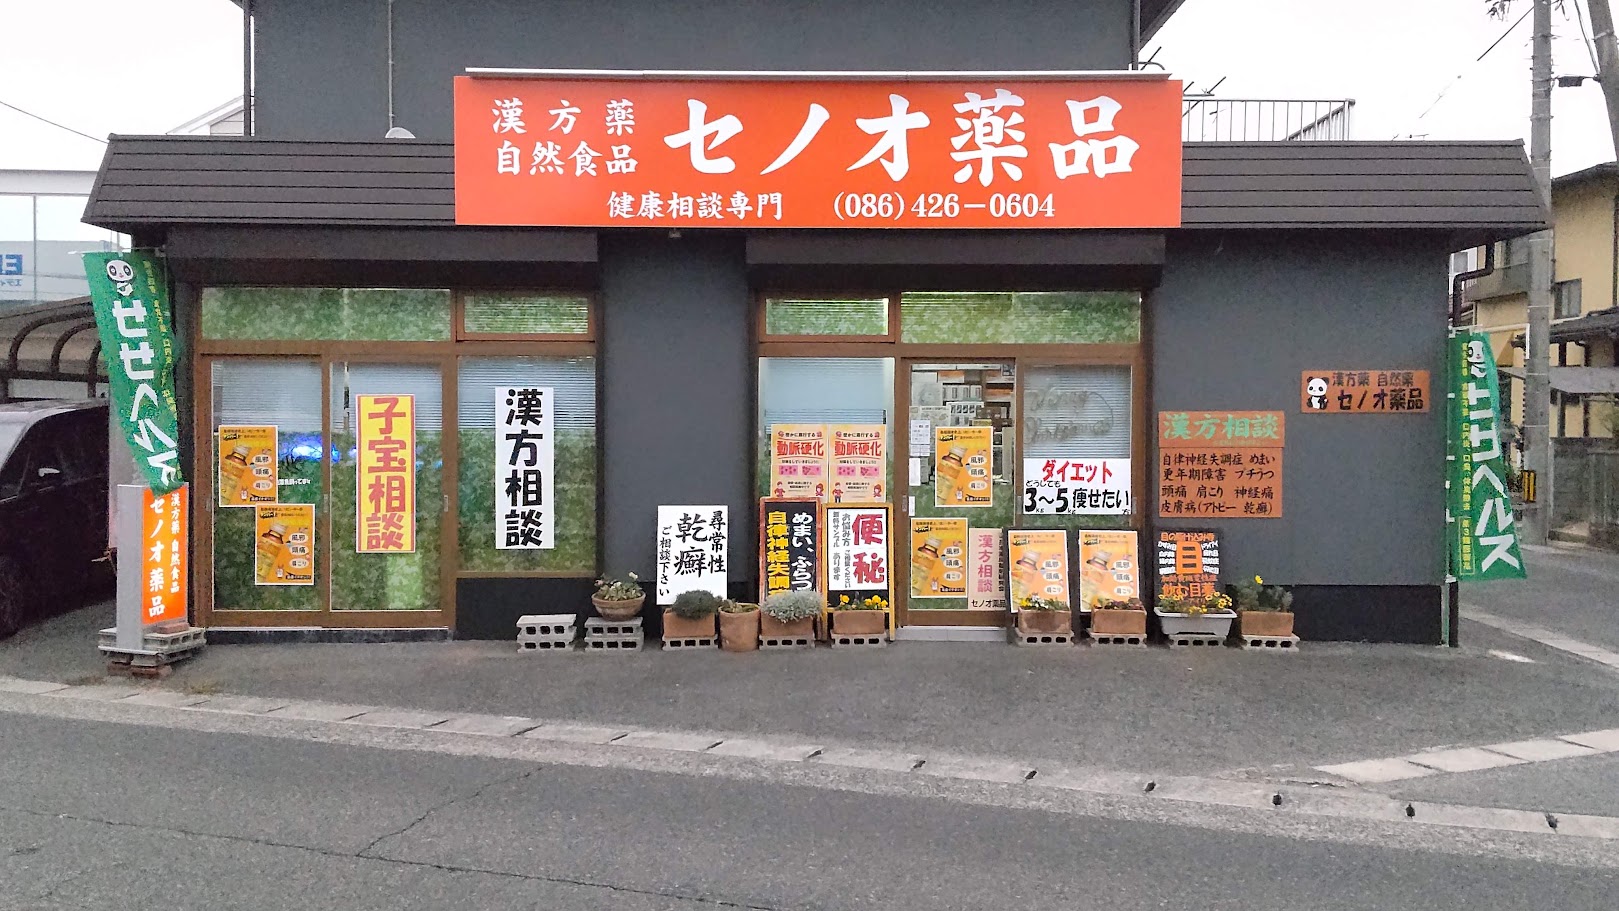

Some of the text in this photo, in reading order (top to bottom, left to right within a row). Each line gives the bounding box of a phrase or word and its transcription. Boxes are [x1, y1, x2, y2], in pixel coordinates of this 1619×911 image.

[491, 98, 637, 136] 漢方薬
[663, 88, 1140, 187] セノオ薬品
[494, 142, 638, 177] 自然食品
[607, 190, 783, 221] 健康相談専門
[1332, 372, 1414, 387] 漢方薬 自然薬
[1337, 387, 1424, 411] セノオ薬品
[1162, 412, 1280, 440] 漢方相談
[776, 440, 824, 456] 動脈硬化
[834, 440, 882, 456] 動脈硬化
[1163, 453, 1275, 466] 自律神経失調症 めまい
[366, 396, 407, 551] 子宝相談
[505, 387, 544, 548] 漢方相談
[1042, 459, 1113, 484] ダイエット
[1163, 468, 1275, 482] 更年期障害 プチうつ
[1025, 479, 1061, 488] どうしても
[1072, 487, 1129, 509] 痩せたい
[1162, 485, 1274, 499] 頭痛 肩こり 神経痛
[170, 493, 181, 534] 漢方薬
[148, 497, 166, 617] セノオ薬品
[673, 512, 708, 578] 乾癬
[707, 510, 726, 574] 尋常性
[851, 513, 885, 584] 便秘
[1176, 540, 1203, 575] 目
[170, 539, 181, 594] 自然食品
[659, 525, 673, 596] ご相談下さい
[833, 552, 841, 581] あります
[977, 533, 993, 593] 漢方相談
[971, 599, 1006, 609] セノオ薬品
[1162, 581, 1216, 598] 飲む目薬
